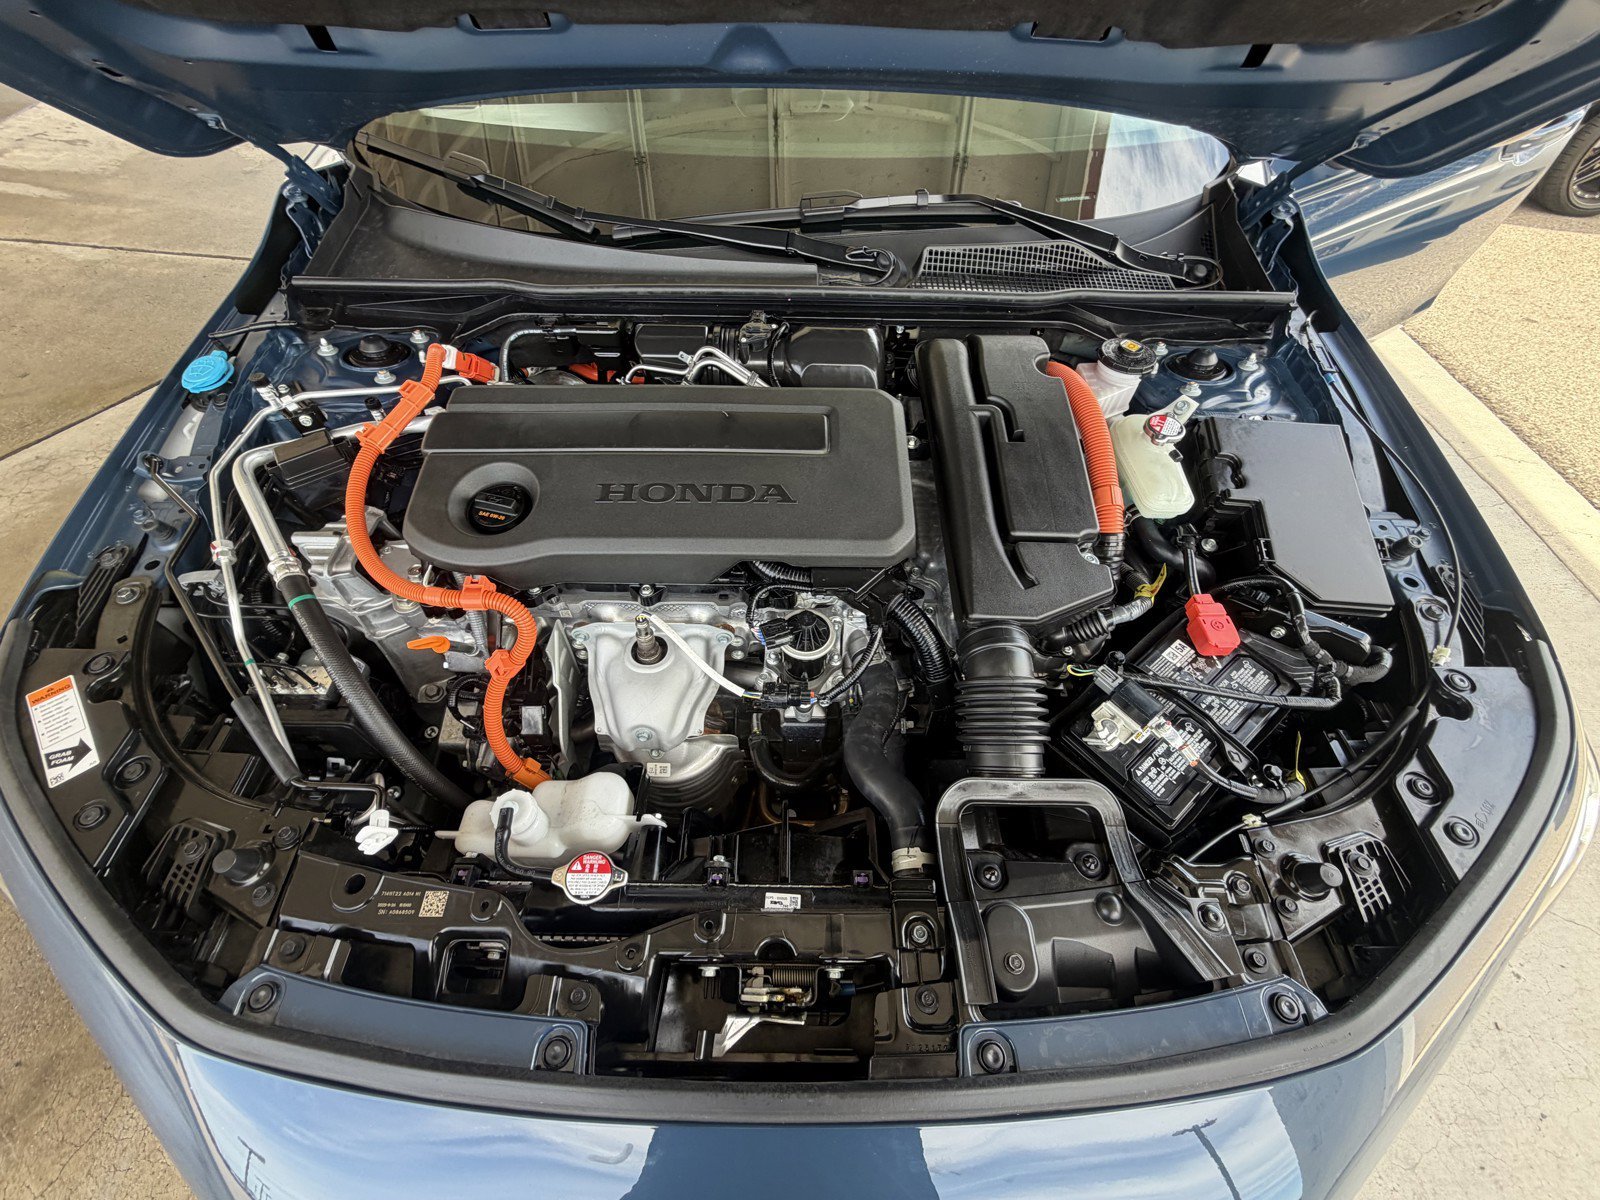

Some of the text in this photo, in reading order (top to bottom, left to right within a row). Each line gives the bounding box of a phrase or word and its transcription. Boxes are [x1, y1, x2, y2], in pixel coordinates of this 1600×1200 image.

[594, 482, 799, 504] HONDA
[478, 510, 490, 518] SAE
[31, 684, 72, 704] WARNING
[48, 750, 73, 760] GRAB
[50, 756, 75, 766] FOAM
